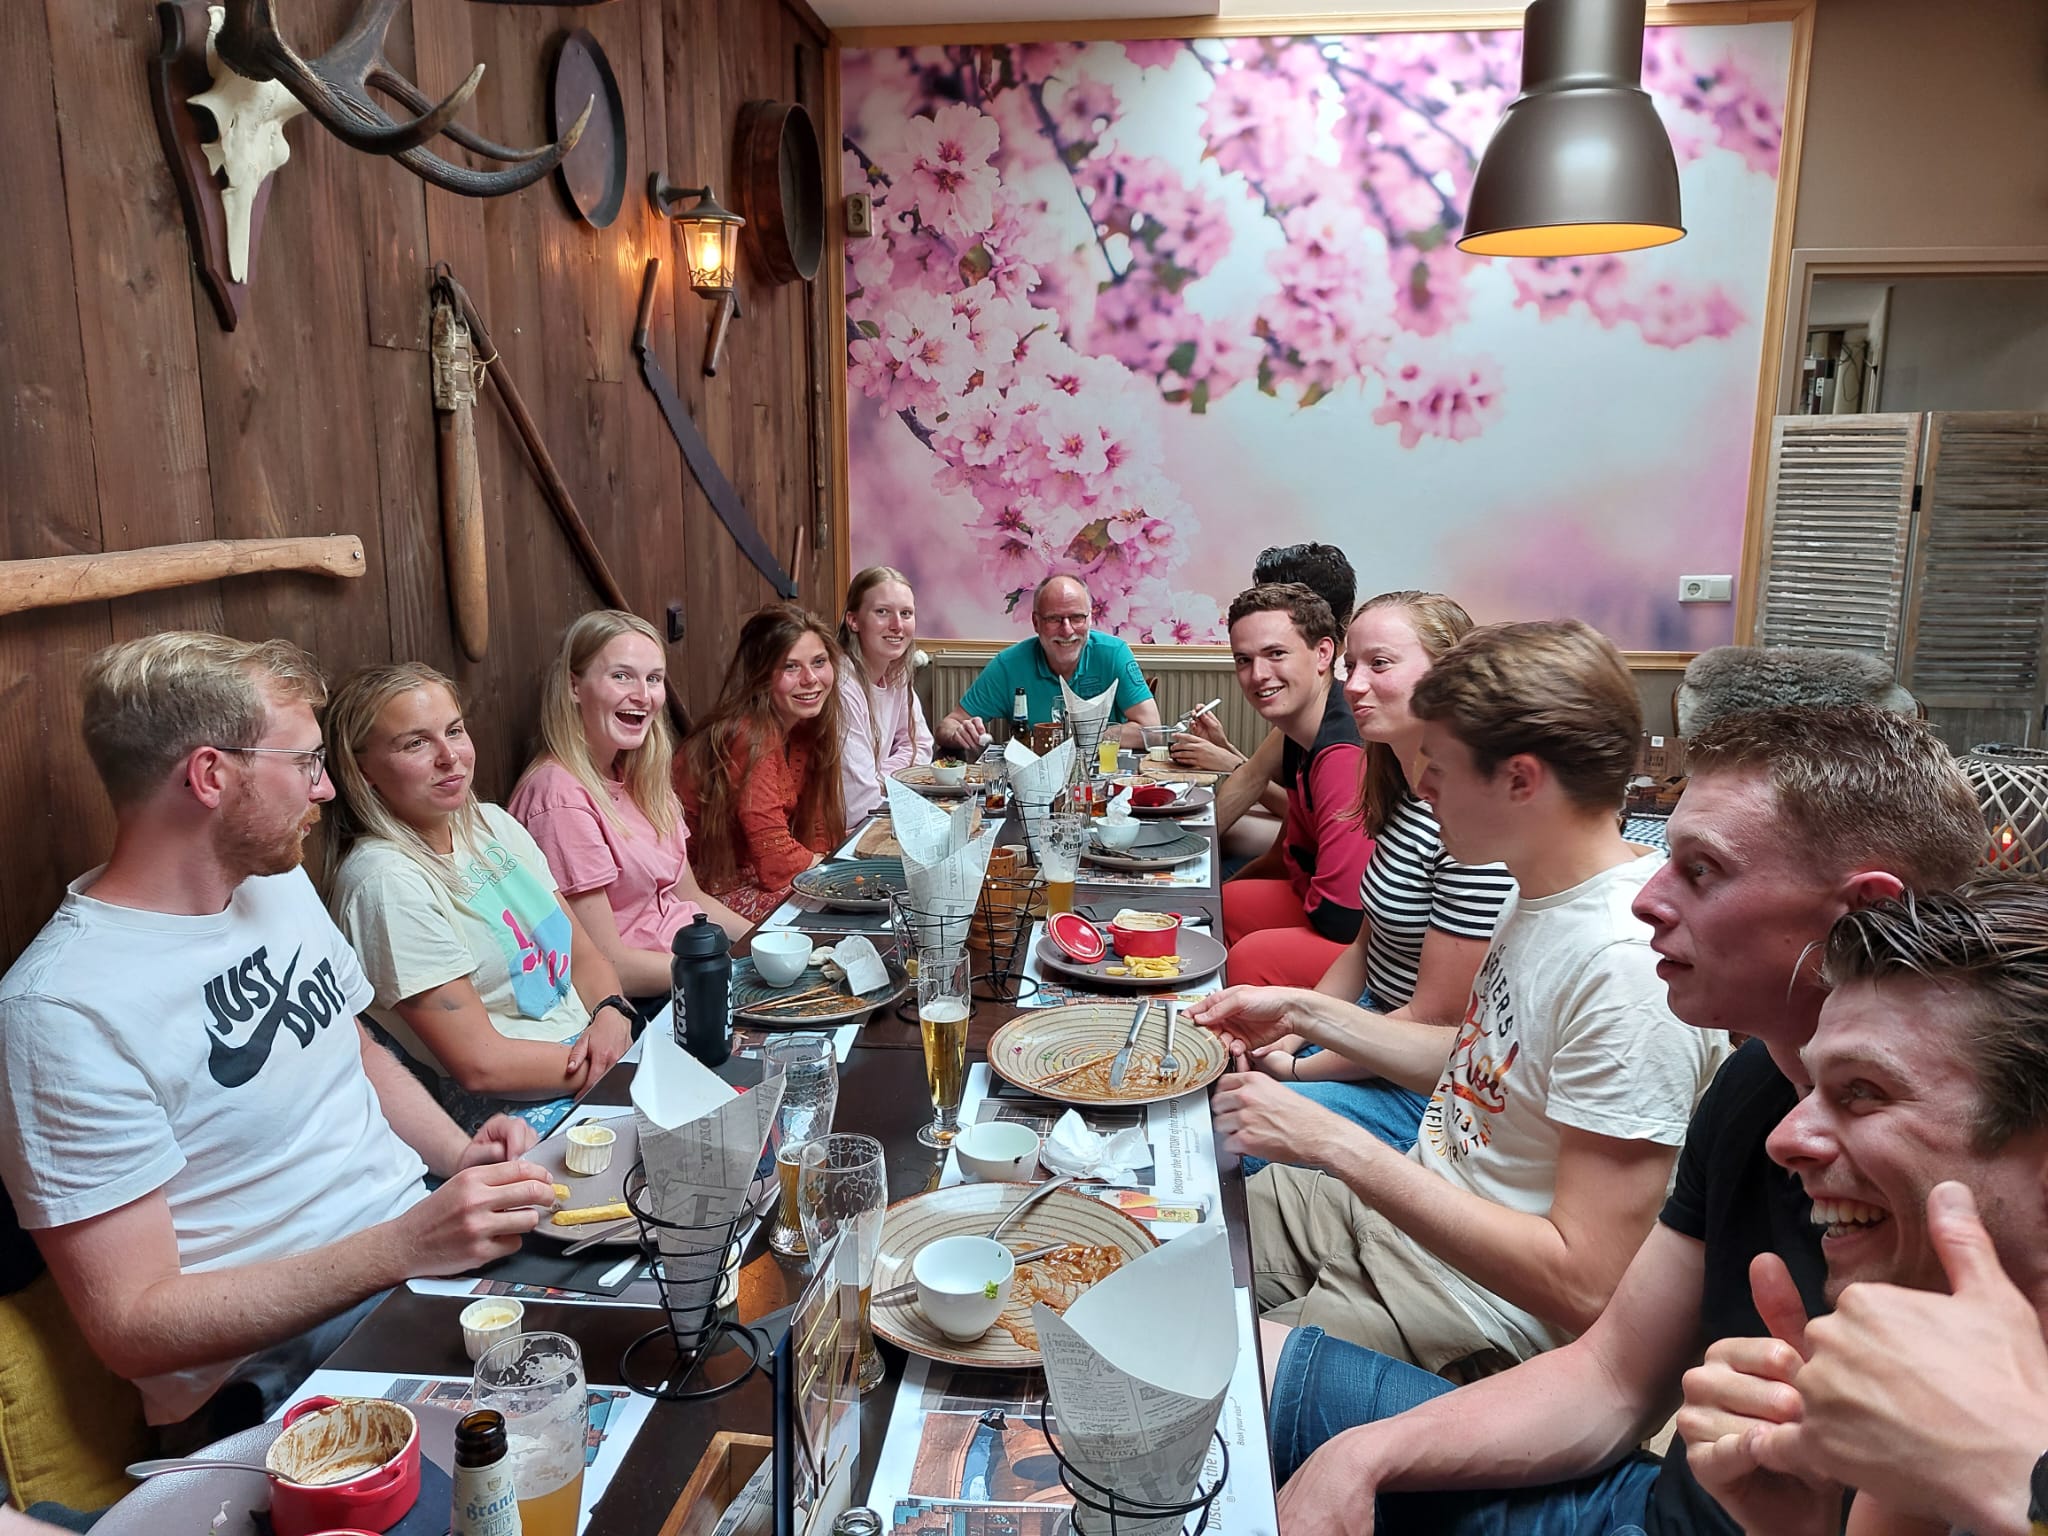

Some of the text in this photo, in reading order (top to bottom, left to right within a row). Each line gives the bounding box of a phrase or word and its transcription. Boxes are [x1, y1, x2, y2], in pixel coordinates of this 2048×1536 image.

[203, 945, 284, 1036] JUST
[674, 984, 688, 1045] Tacx
[1168, 1119, 1179, 1128] the
[1169, 1134, 1181, 1158] HISTORY
[1170, 1158, 1182, 1169] the
[1172, 1169, 1184, 1195] Discover
[1203, 1458, 1218, 1477] the
[466, 1485, 515, 1520] Brand
[1207, 1481, 1222, 1531] Discoer
